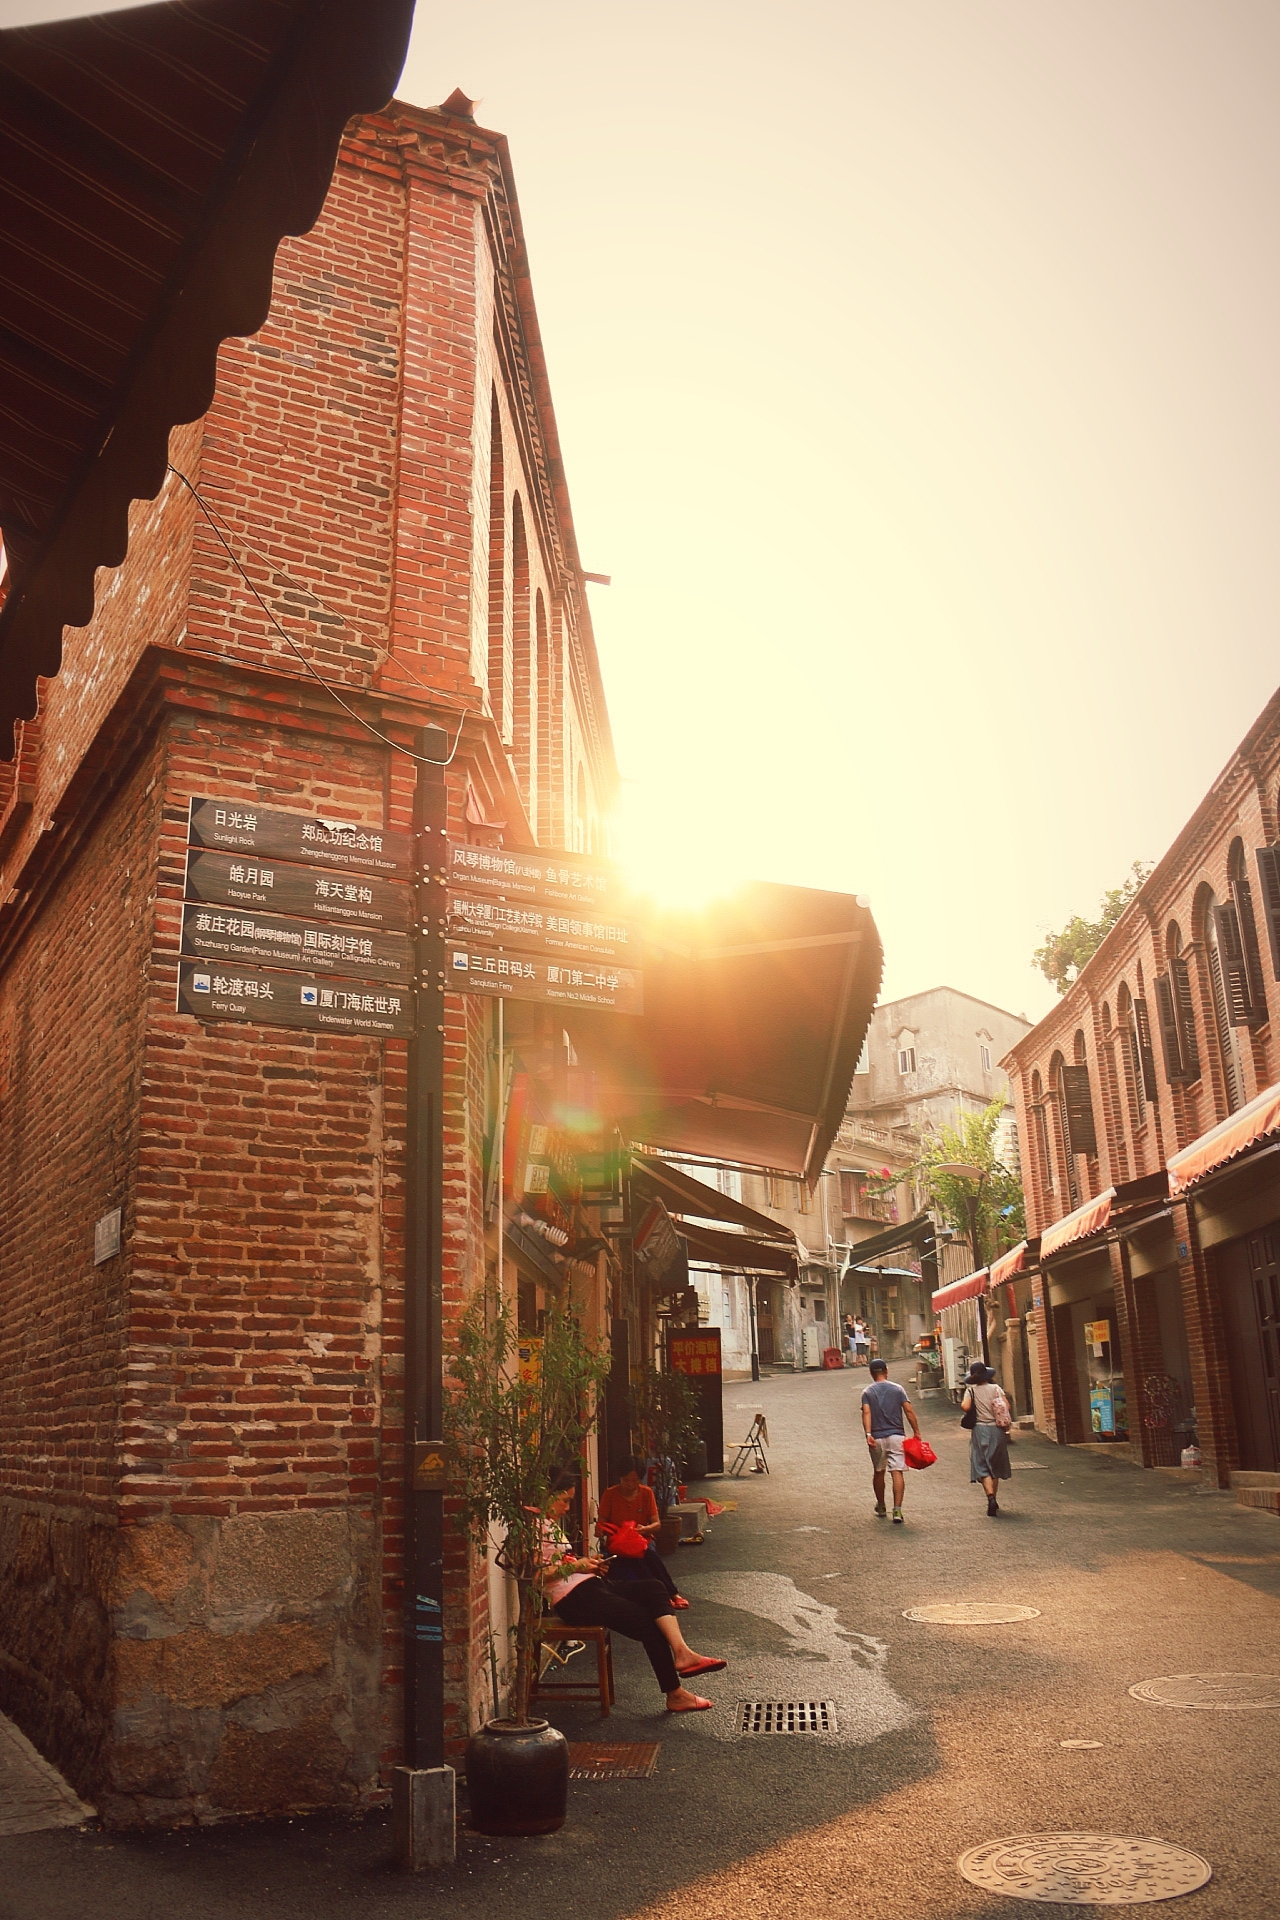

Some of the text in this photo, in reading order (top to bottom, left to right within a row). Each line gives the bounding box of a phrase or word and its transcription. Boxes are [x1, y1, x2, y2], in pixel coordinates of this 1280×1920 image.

[214, 809, 258, 832] 日光岩
[213, 832, 256, 846] Sunlight Rock
[301, 824, 383, 853] 郑成功纪念馆
[349, 855, 375, 866] Memorial
[375, 859, 397, 869] Museum
[229, 864, 274, 888] 皓月园
[452, 872, 470, 883] Organ
[545, 866, 607, 892] 鱼骨艺术馆
[227, 888, 267, 902] Haoyue Park
[315, 879, 373, 904] 海天堂构
[544, 888, 595, 905] Fishbone Art Gallery
[313, 902, 383, 921] Haitiantanggou Mansion
[453, 899, 543, 928] 福州大学厦门工艺美术学院
[472, 926, 495, 938] University
[485, 920, 502, 930] Design
[546, 915, 628, 944] 美国领事馆旧址
[194, 937, 229, 952] Shuzhuang
[304, 929, 373, 957] 国际刻字馆
[545, 937, 616, 956] Former American Consulate
[301, 955, 335, 968] Art Gallery
[302, 946, 401, 969] International Calligraphic Carving
[470, 955, 536, 980] 三丘田码头
[212, 975, 275, 1001] 轮渡码头
[469, 977, 514, 992] Sanqiutian Ferry
[547, 966, 619, 991] 厦门第二中学
[319, 990, 402, 1016] 厦门海底世界
[546, 988, 616, 1005] Xiamen No.2 Middle School
[211, 1000, 247, 1014] Ferry Quay
[318, 1013, 394, 1030] Underwater World Xiamen
[672, 1340, 718, 1356] 平价海鲜
